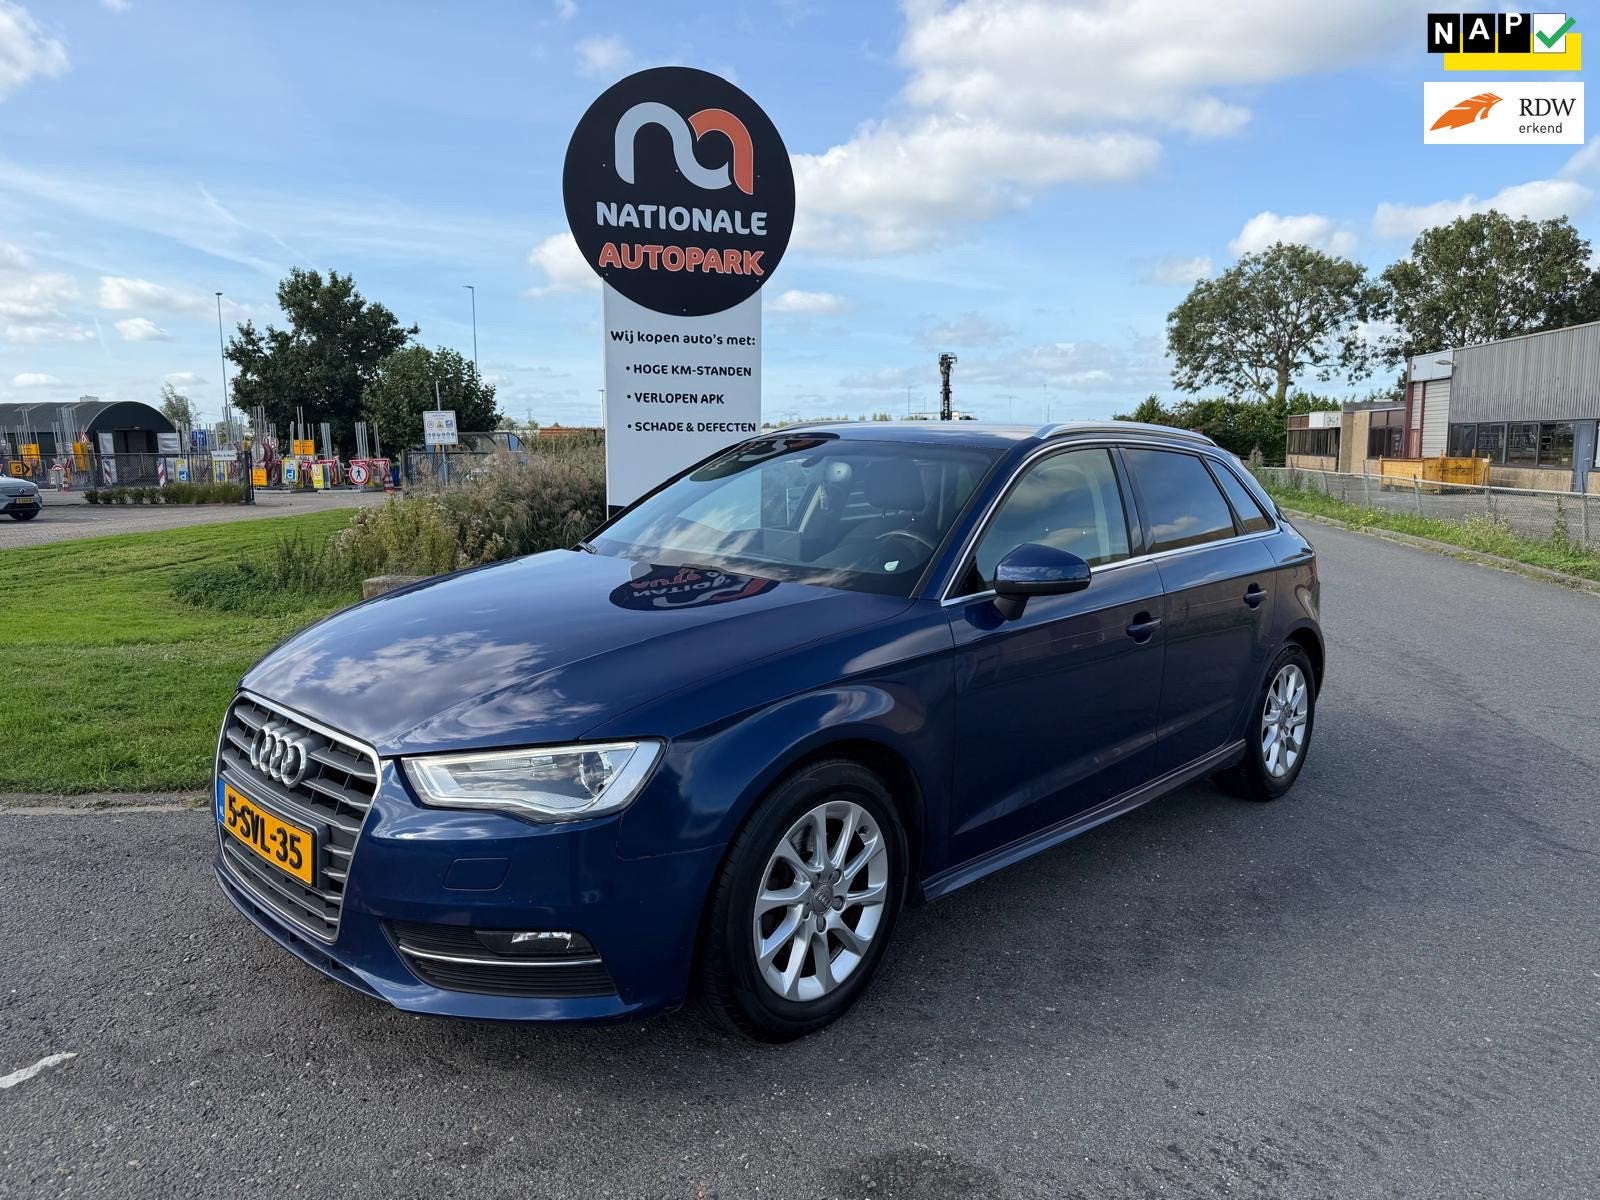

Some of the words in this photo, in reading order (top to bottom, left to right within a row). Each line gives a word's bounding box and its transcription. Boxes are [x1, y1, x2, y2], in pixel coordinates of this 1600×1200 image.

[596, 201, 768, 236] NATIONALE
[598, 242, 765, 276] AUTOPARK
[610, 330, 634, 344] Wij
[637, 331, 680, 345] kopen
[683, 334, 723, 345] auto's
[726, 335, 756, 346] met:
[633, 364, 668, 375] HOGE
[671, 365, 752, 377] KM-STANDEN
[634, 392, 698, 404] VERLOPEN
[700, 393, 725, 404] APK
[634, 421, 684, 432] SCHADE
[686, 422, 694, 432] &
[697, 422, 756, 432] DEFECTEN
[228, 794, 303, 869] 5-SVL-35
